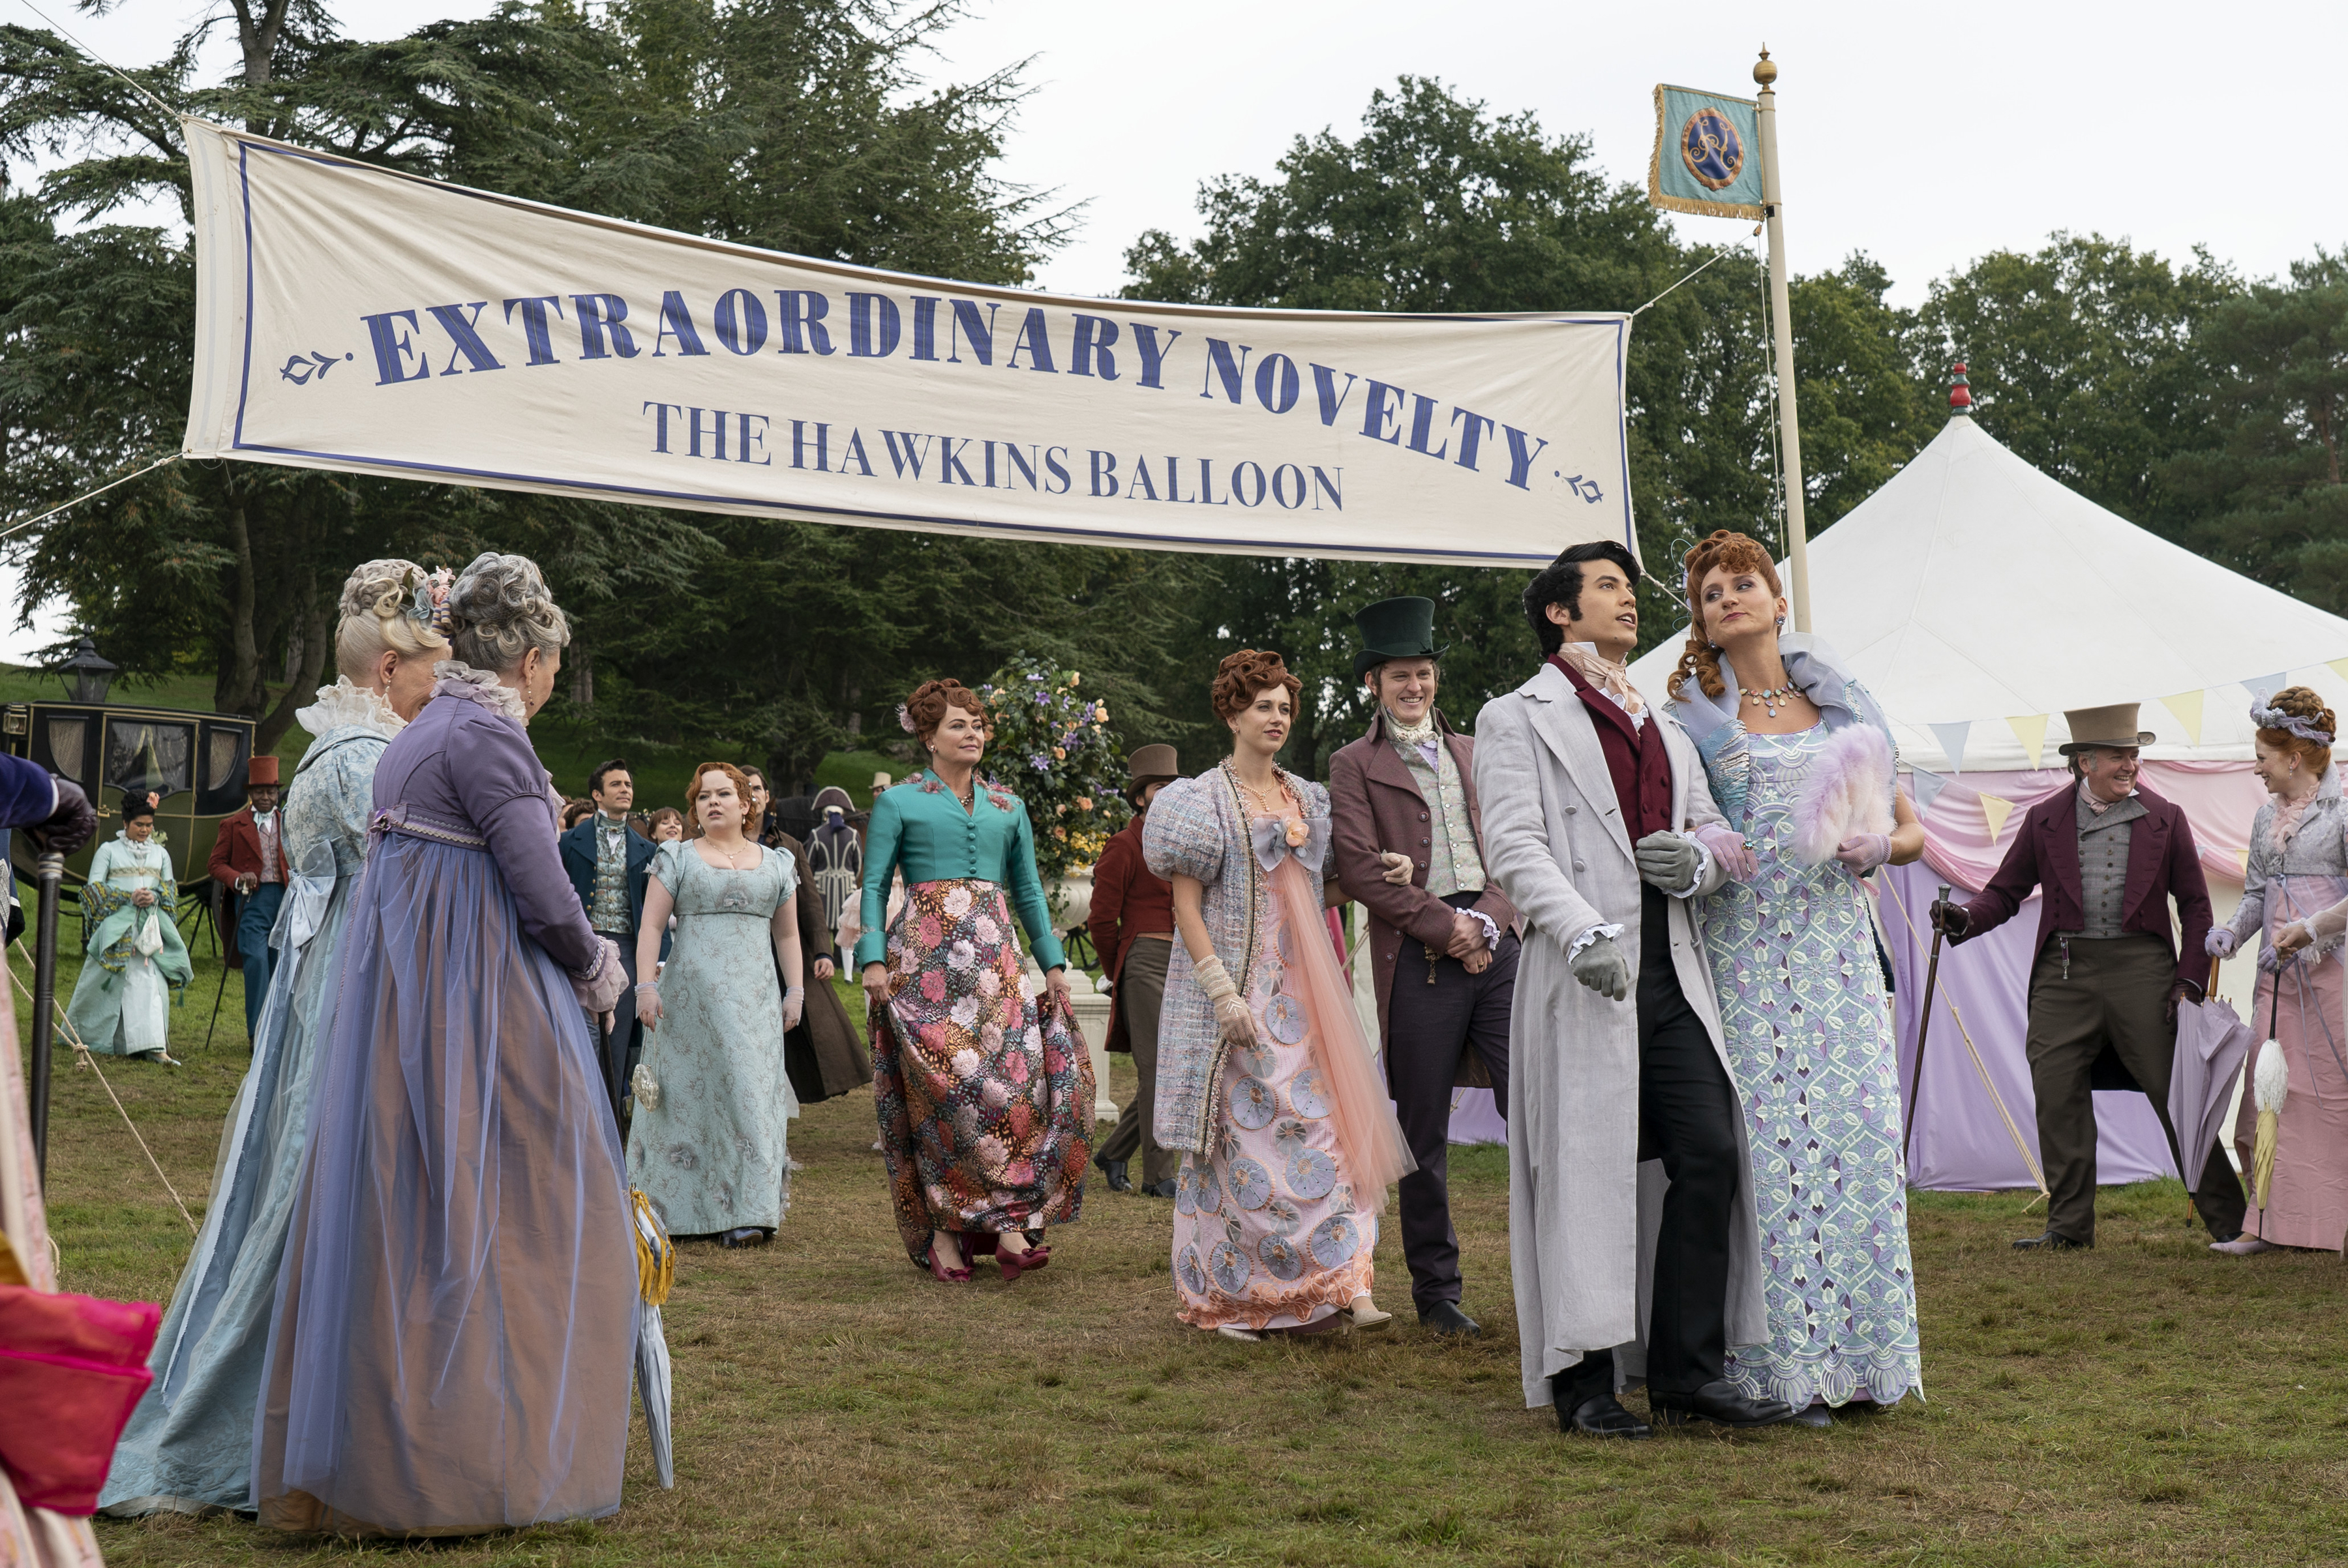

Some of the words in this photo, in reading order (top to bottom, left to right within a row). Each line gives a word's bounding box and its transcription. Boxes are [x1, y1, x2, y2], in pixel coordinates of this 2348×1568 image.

[359, 288, 1182, 390] EXTRAORDINARY
[1199, 337, 1549, 491] NOVELTY
[642, 400, 772, 466] THE
[789, 419, 1072, 494] HAWKINS
[1088, 449, 1344, 511] BALLOON
